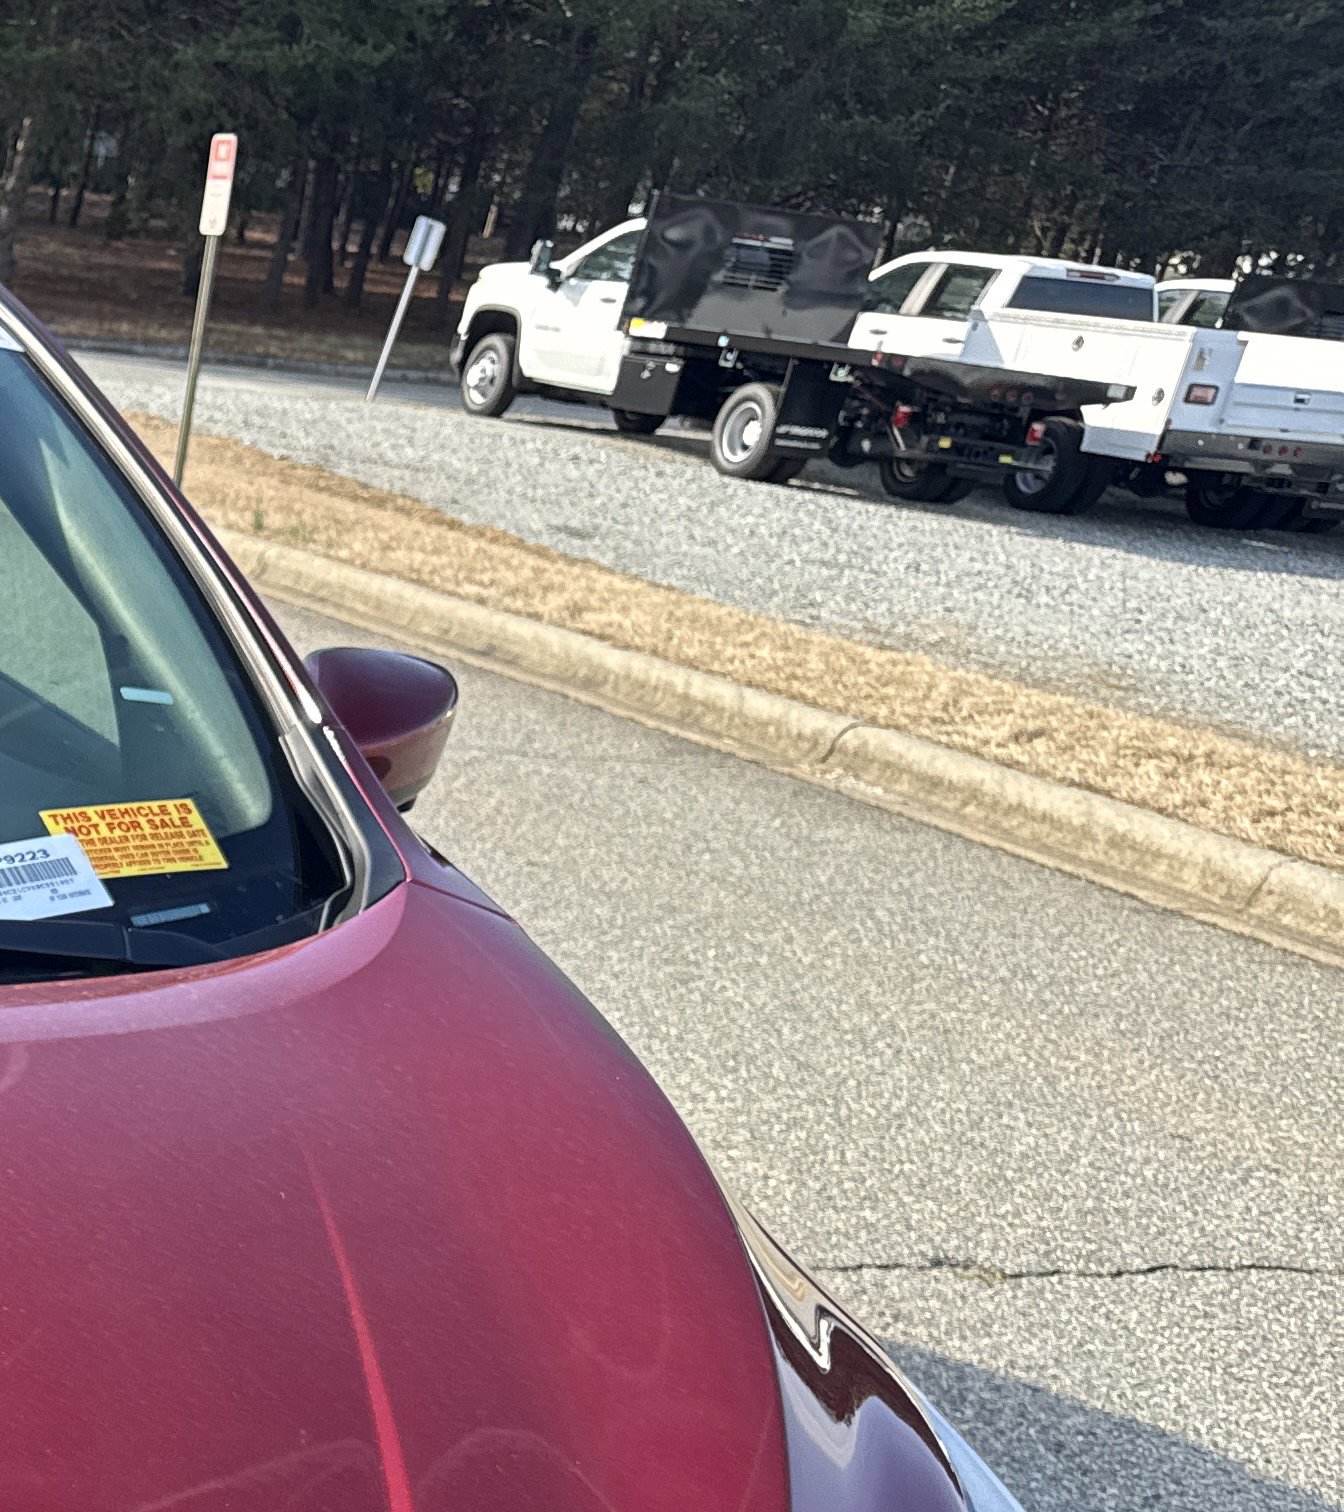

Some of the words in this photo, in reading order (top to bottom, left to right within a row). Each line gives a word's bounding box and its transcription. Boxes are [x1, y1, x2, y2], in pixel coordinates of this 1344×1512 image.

[47, 811, 92, 826] THIS
[94, 803, 172, 822] VEHICLE
[174, 803, 193, 815] IS
[64, 823, 102, 837] NOT
[106, 820, 143, 835] FOR
[147, 816, 193, 831] SALE
[97, 835, 130, 848] DEALER
